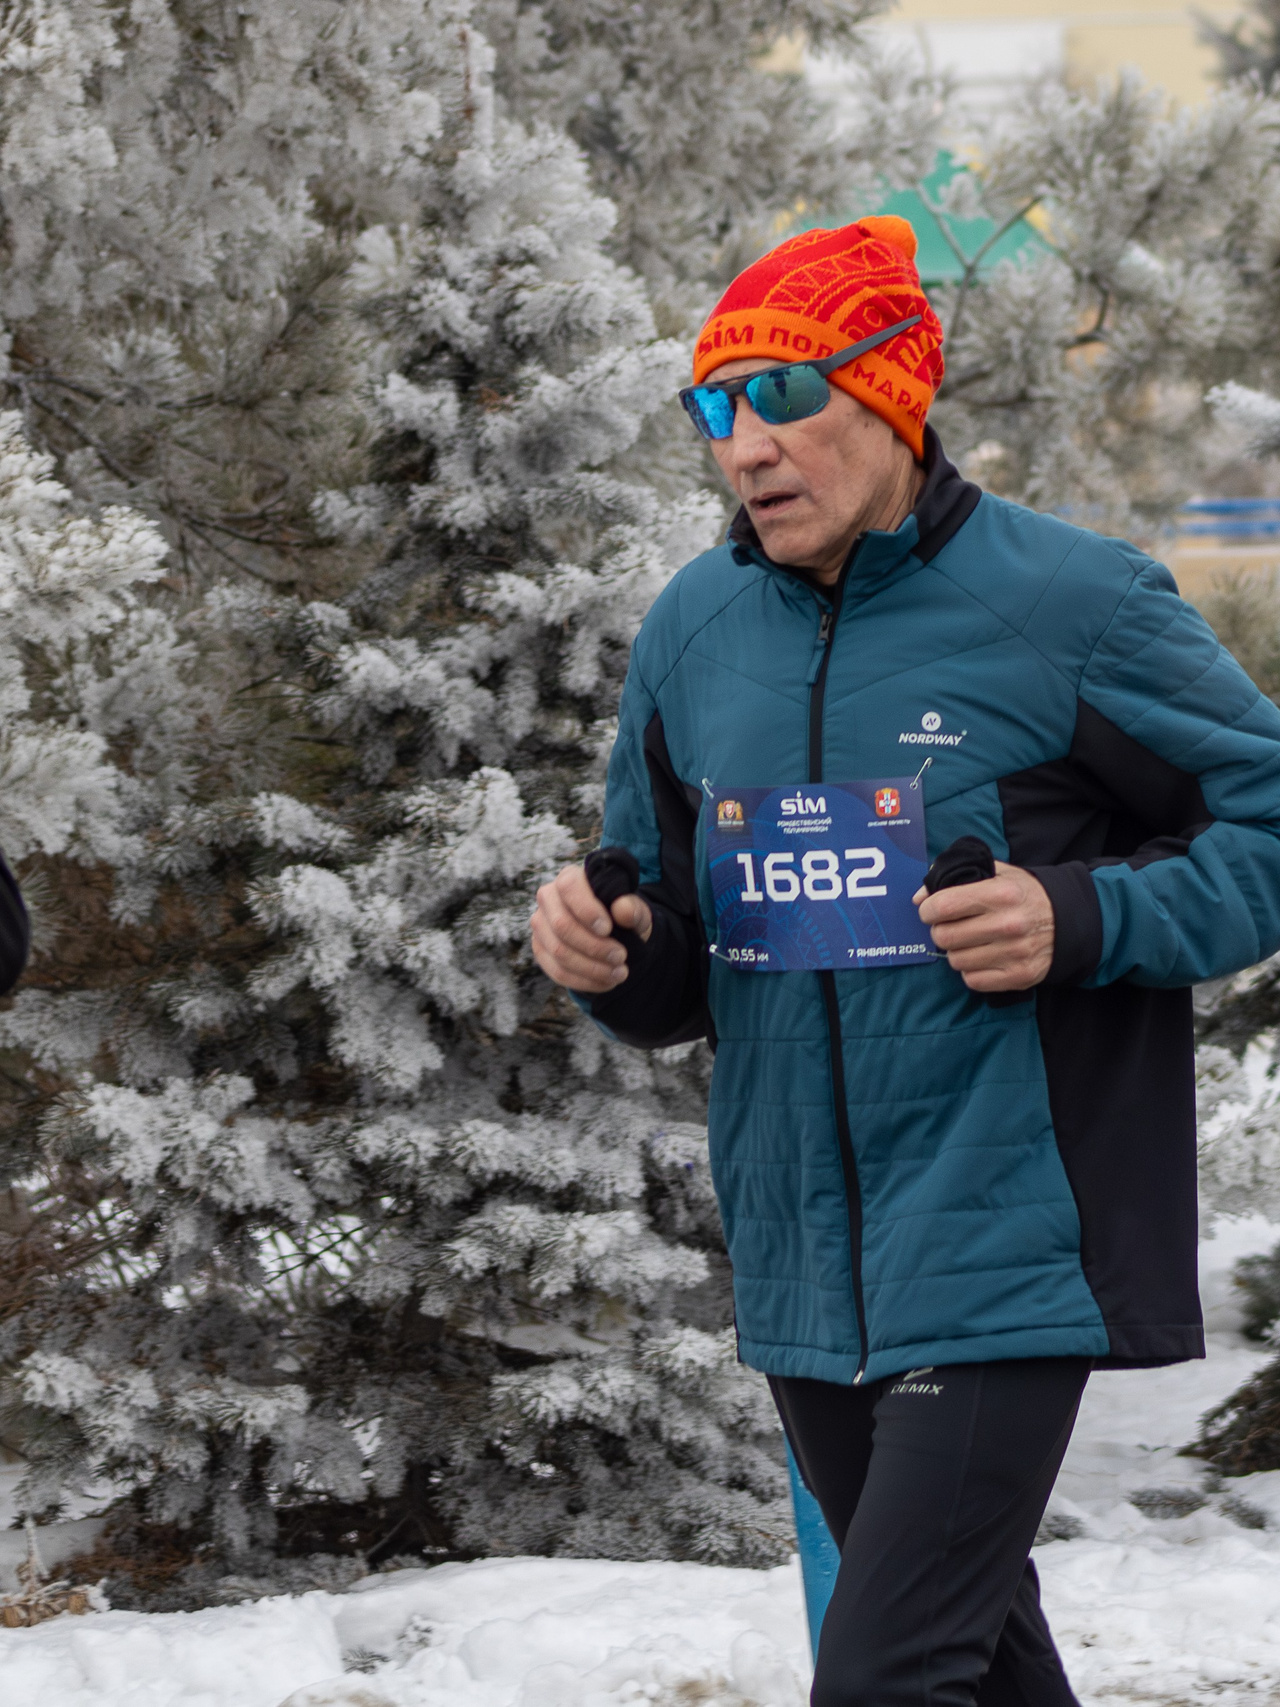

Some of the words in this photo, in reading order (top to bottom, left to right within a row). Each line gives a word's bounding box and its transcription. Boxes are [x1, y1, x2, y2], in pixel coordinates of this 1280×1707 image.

[899, 732, 963, 746] NORDWAY
[736, 847, 888, 903] 1682
[847, 948, 855, 958] 7
[898, 943, 926, 955] 2025
[890, 1383, 944, 1395] DEMIX
